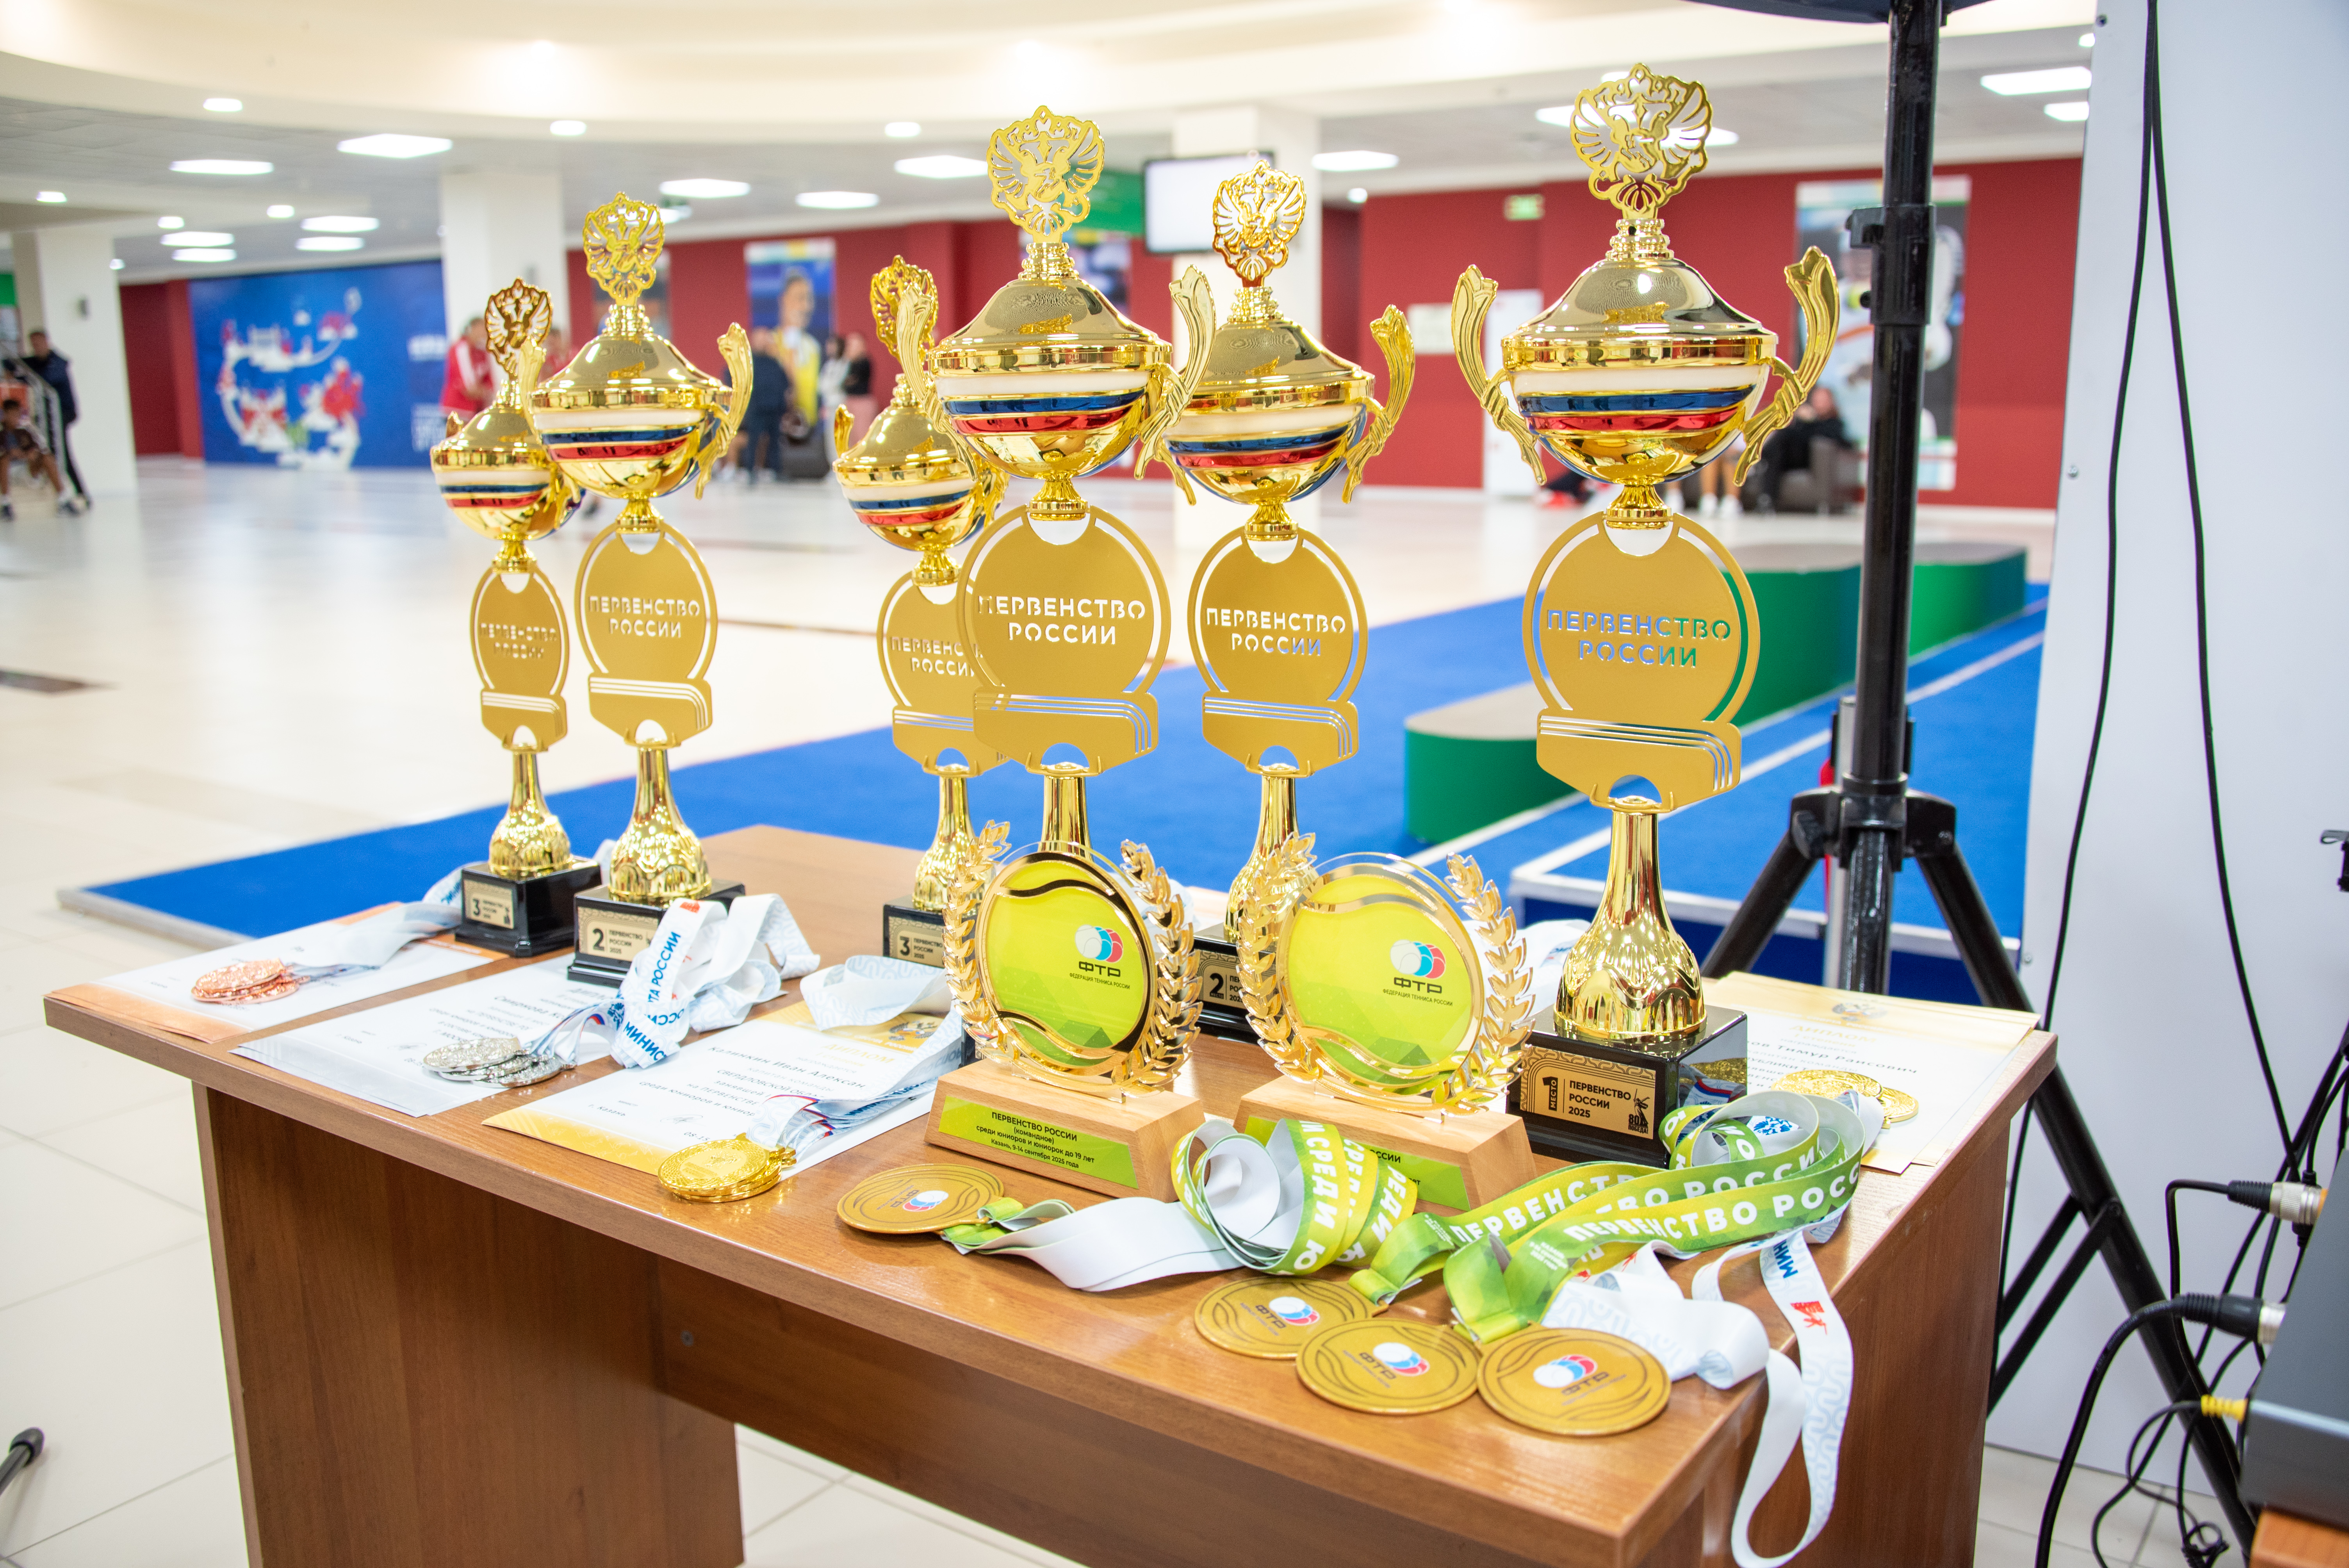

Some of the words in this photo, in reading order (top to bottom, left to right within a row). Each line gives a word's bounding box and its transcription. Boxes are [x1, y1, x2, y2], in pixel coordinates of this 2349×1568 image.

[589, 596, 700, 617] ПЕРВЕНСТВО
[979, 595, 1146, 619] ПЕРВЕНСТВО
[609, 619, 681, 638] РОССИИ
[1207, 608, 1346, 633] ПЕРВЕНСТВО
[1547, 610, 1731, 640] ПЕРВЕНСТВО
[1009, 623, 1116, 645] РОССИИ
[1232, 634, 1321, 656] РОССИИ
[891, 637, 982, 657] ПЕРВЕНС
[1579, 640, 1696, 668] РОССИИ
[473, 899, 479, 916] 3
[593, 928, 604, 950] 2
[900, 936, 910, 955] 3
[652, 932, 681, 987] РОССИИ
[1079, 961, 1121, 977] ФТР
[1069, 973, 1093, 982] ФЕДЕРАЦИЯ
[1094, 978, 1113, 986] ТЕННИСА
[1210, 973, 1224, 999] 2
[1394, 977, 1442, 994] ФТР
[1383, 989, 1410, 998] ФЕДЕРАЦИЯ
[1412, 994, 1433, 1003] ТЕННИСА
[1434, 998, 1453, 1007] РОССИИ
[623, 1021, 667, 1061] МИНИС
[821, 1044, 895, 1064] ДИПЛОМ
[1778, 1045, 1829, 1058] Тимур
[1835, 1056, 1917, 1073] Раисович
[708, 1046, 771, 1064] Калинкин
[773, 1061, 807, 1073] Иван
[810, 1071, 866, 1090] Алексан
[714, 1080, 766, 1096] занявшей
[717, 1069, 790, 1092] СВЕРДЛОВСКОЙ
[790, 1089, 824, 1098] ОБЛА
[1542, 1076, 1558, 1112] 1
[1570, 1080, 1631, 1100] ПЕРВЕНСТВО
[639, 1082, 668, 1091] среди
[668, 1089, 713, 1104] юниоров
[723, 1105, 755, 1117] юниор
[700, 1087, 760, 1106] ПЕРВЕНСТВЕ
[1569, 1093, 1610, 1109] РОССИИ
[597, 1106, 626, 1117] Казань
[1568, 1106, 1591, 1118] 2025
[1629, 1114, 1640, 1125] 80
[992, 1112, 1043, 1131] ПЕРВЕНСТВО
[1044, 1126, 1077, 1142] РОССИИ
[1014, 1127, 1054, 1145] (командное)
[1628, 1125, 1649, 1134] ПОБЕДА!
[976, 1125, 996, 1135] среди
[997, 1131, 1026, 1144] юниоров
[1034, 1142, 1064, 1155] юниорок
[991, 1139, 1011, 1150] Казань,
[1025, 1148, 1051, 1160] сентября
[1052, 1156, 1065, 1164] 2025
[1370, 1149, 1401, 1163] ССИИ
[1684, 1135, 1820, 1199] РОССИ
[1306, 1137, 1338, 1229] СРЕДИ
[890, 1189, 920, 1208] ФТР
[1371, 1164, 1406, 1243] РЕДИ
[1449, 1175, 1634, 1243] ПЕРВЕНСТ
[1563, 1201, 1757, 1242] ПЕРВЕНСТВО
[1772, 1162, 1860, 1218] РОСС
[1255, 1305, 1286, 1328] ФТР
[1359, 1352, 1396, 1379] ФТР
[1561, 1371, 1609, 1396] ФТР
